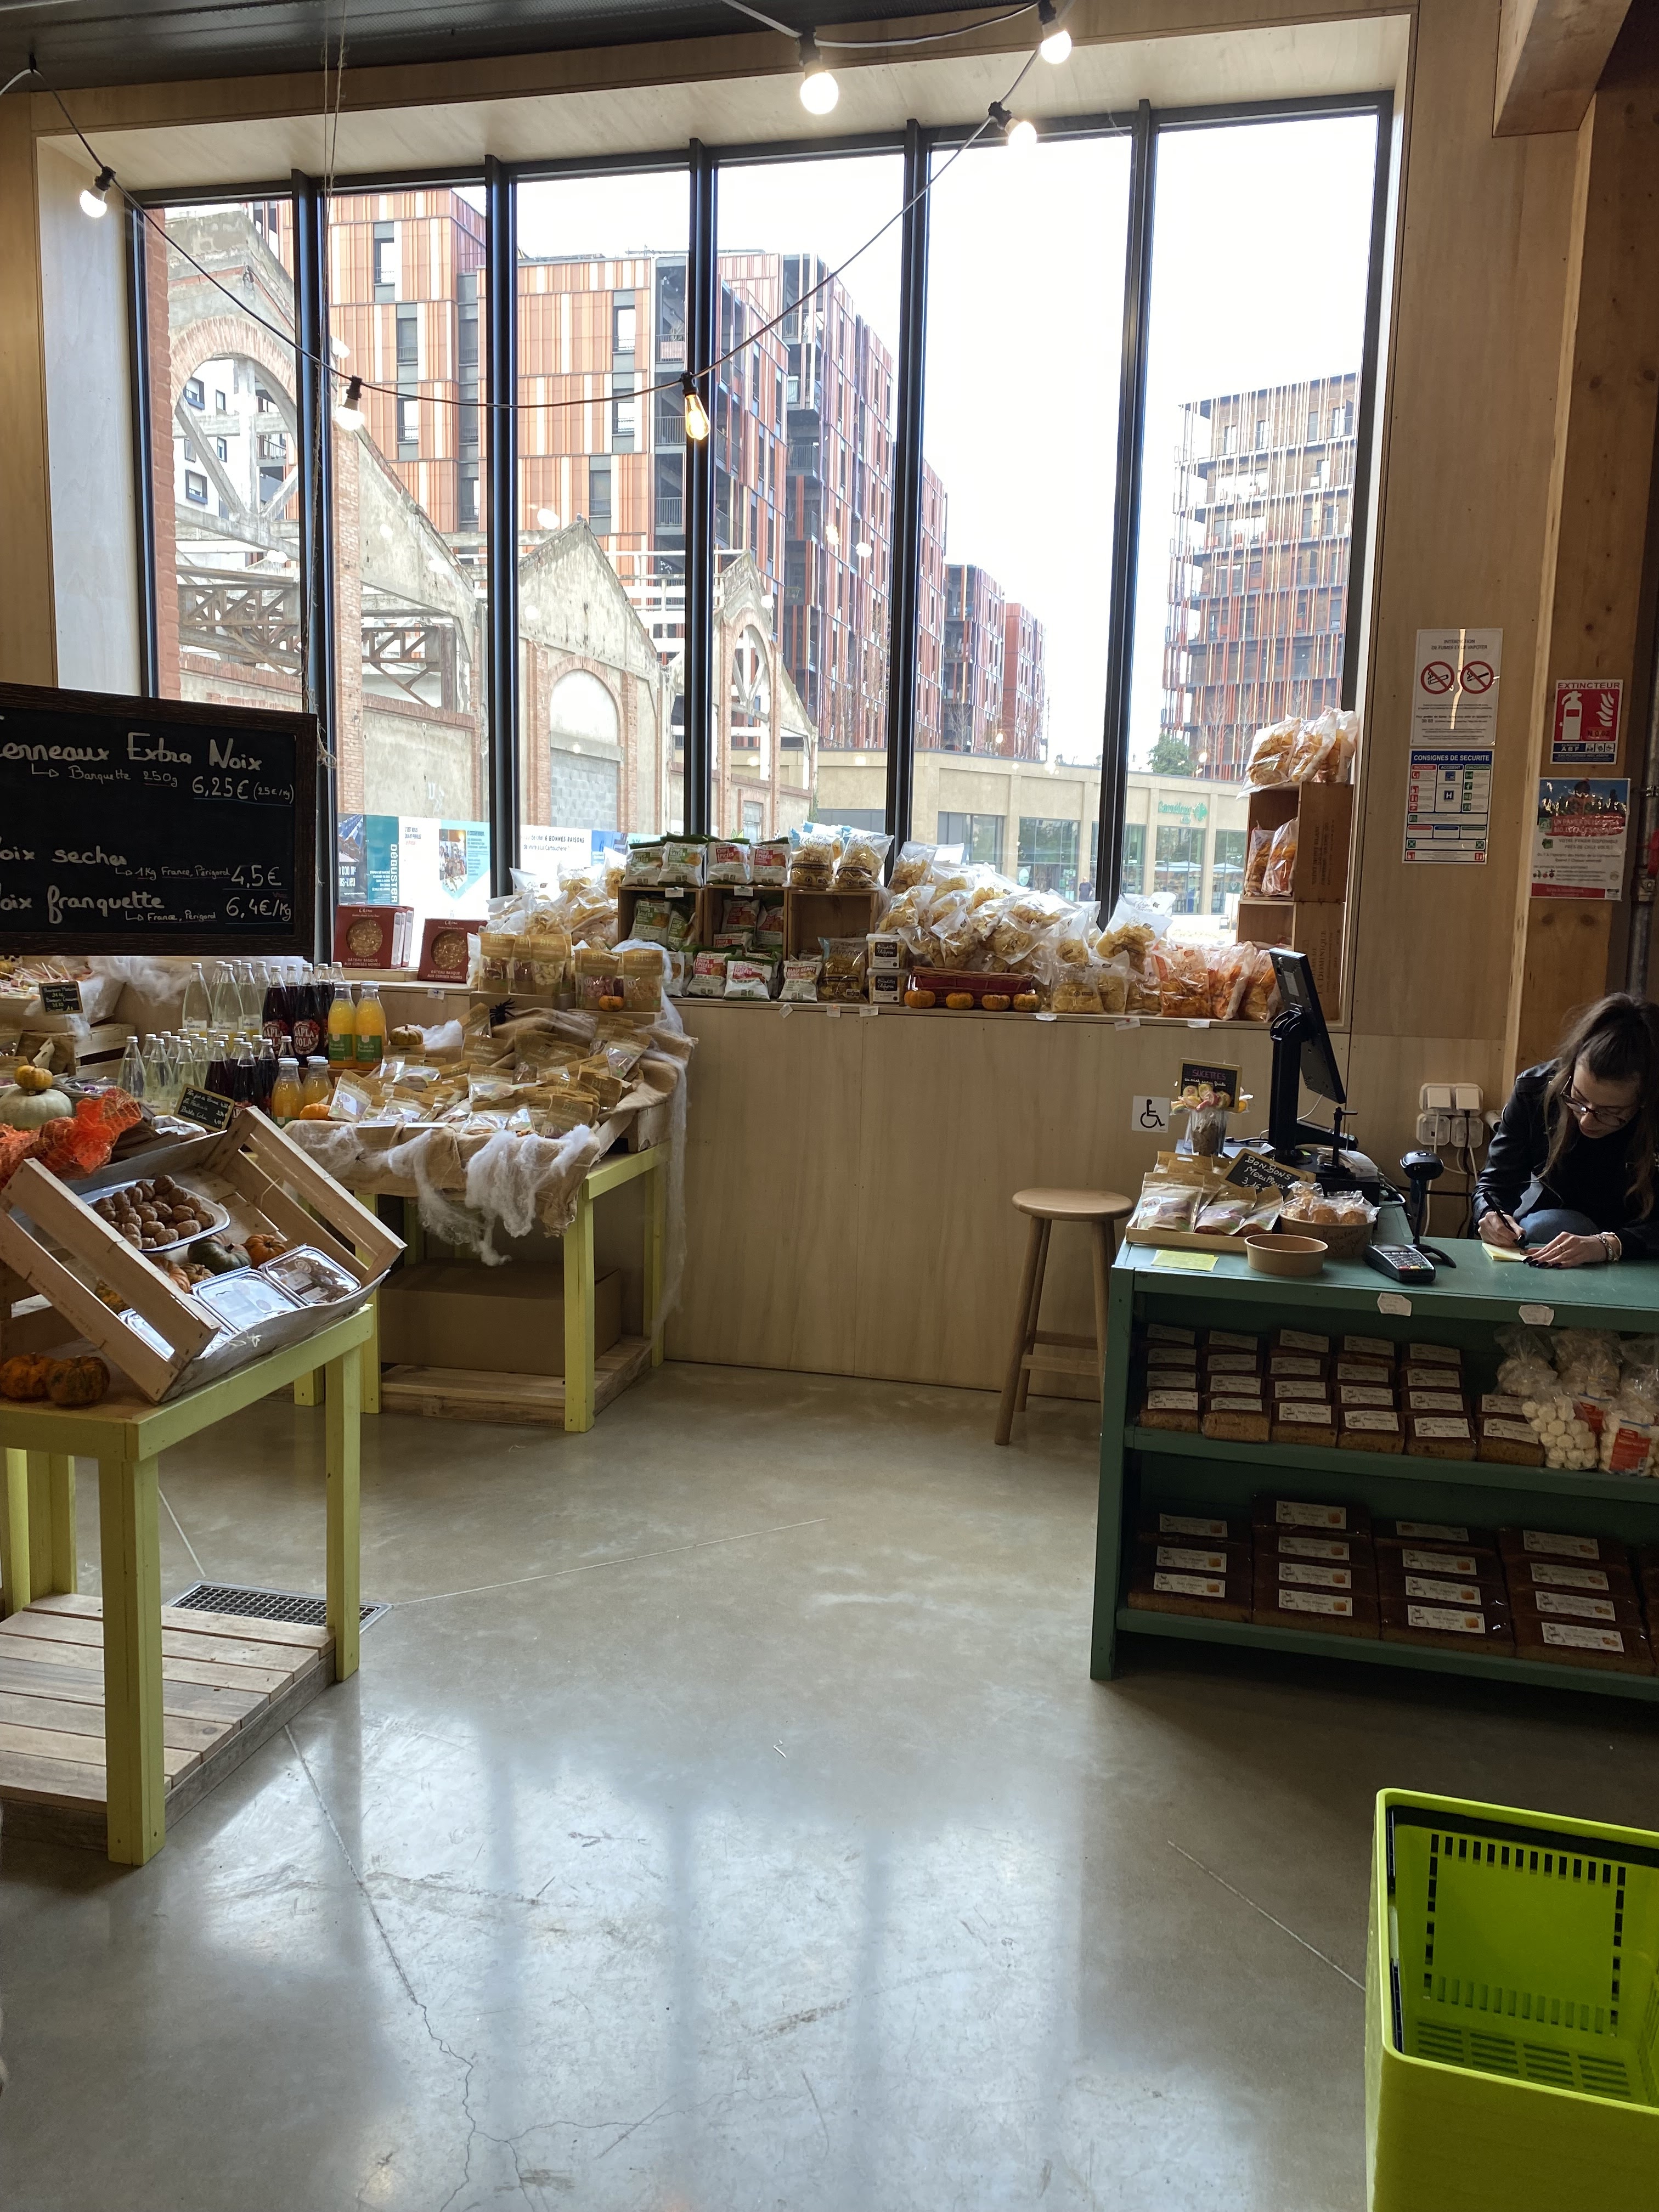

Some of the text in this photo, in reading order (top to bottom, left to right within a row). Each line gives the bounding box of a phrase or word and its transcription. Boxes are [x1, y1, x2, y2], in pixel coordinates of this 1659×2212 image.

[0, 732, 262, 770] erneaux Extra Noix
[143, 771, 178, 788] 250g
[191, 776, 250, 800] 6,25€
[0, 844, 36, 861] oix
[230, 865, 282, 889] 4,5€
[0, 884, 166, 925] oix franquette
[1317, 930, 1327, 981] DOMINIQUE
[295, 1037, 313, 1047] COLA
[1192, 1069, 1226, 1081] SUCETTES
